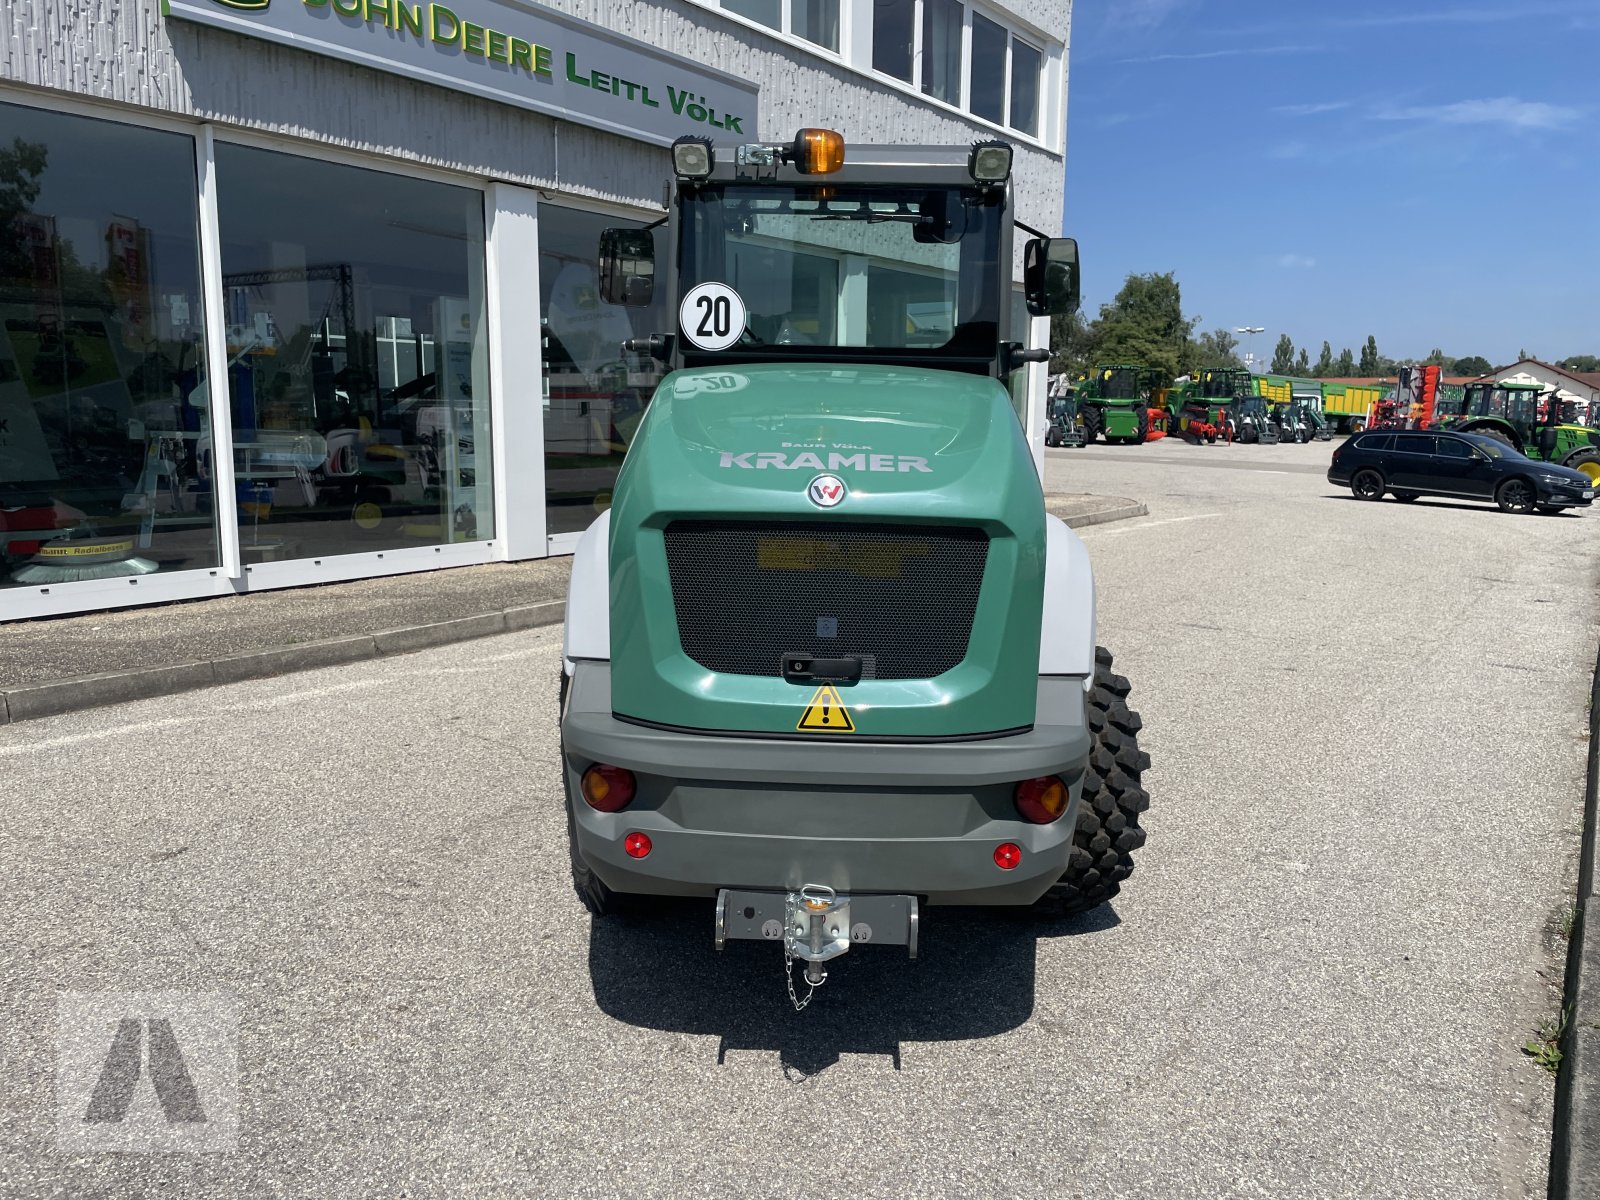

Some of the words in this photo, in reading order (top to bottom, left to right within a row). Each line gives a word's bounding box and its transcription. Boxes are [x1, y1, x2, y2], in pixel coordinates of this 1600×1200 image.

[430, 2, 553, 77] DEERE
[565, 51, 660, 108] LEITL
[666, 85, 744, 135] VÖLK
[696, 295, 731, 337] 20
[719, 452, 934, 473] KRAMER
